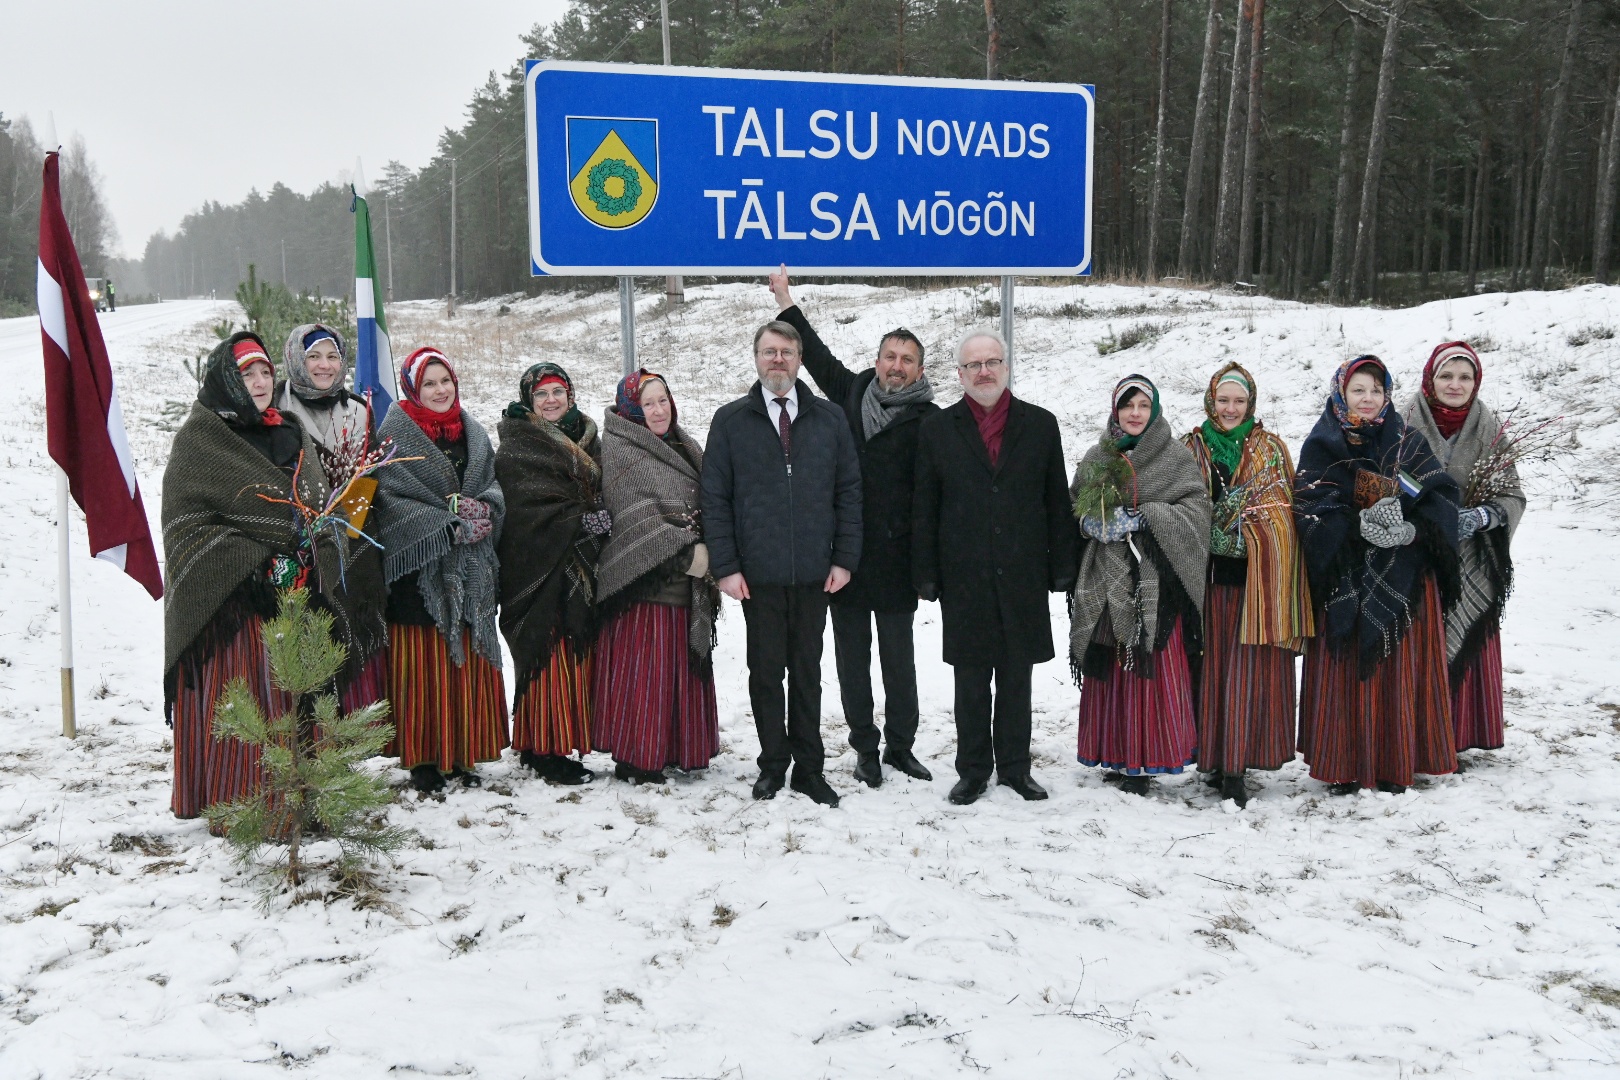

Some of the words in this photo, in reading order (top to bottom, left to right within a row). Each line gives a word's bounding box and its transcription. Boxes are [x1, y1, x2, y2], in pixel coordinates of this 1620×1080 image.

[702, 105, 878, 160] TALSU
[897, 118, 1050, 159] NOVADS
[703, 178, 881, 241] TĀLSA
[897, 190, 1035, 237] MŌGÕN
